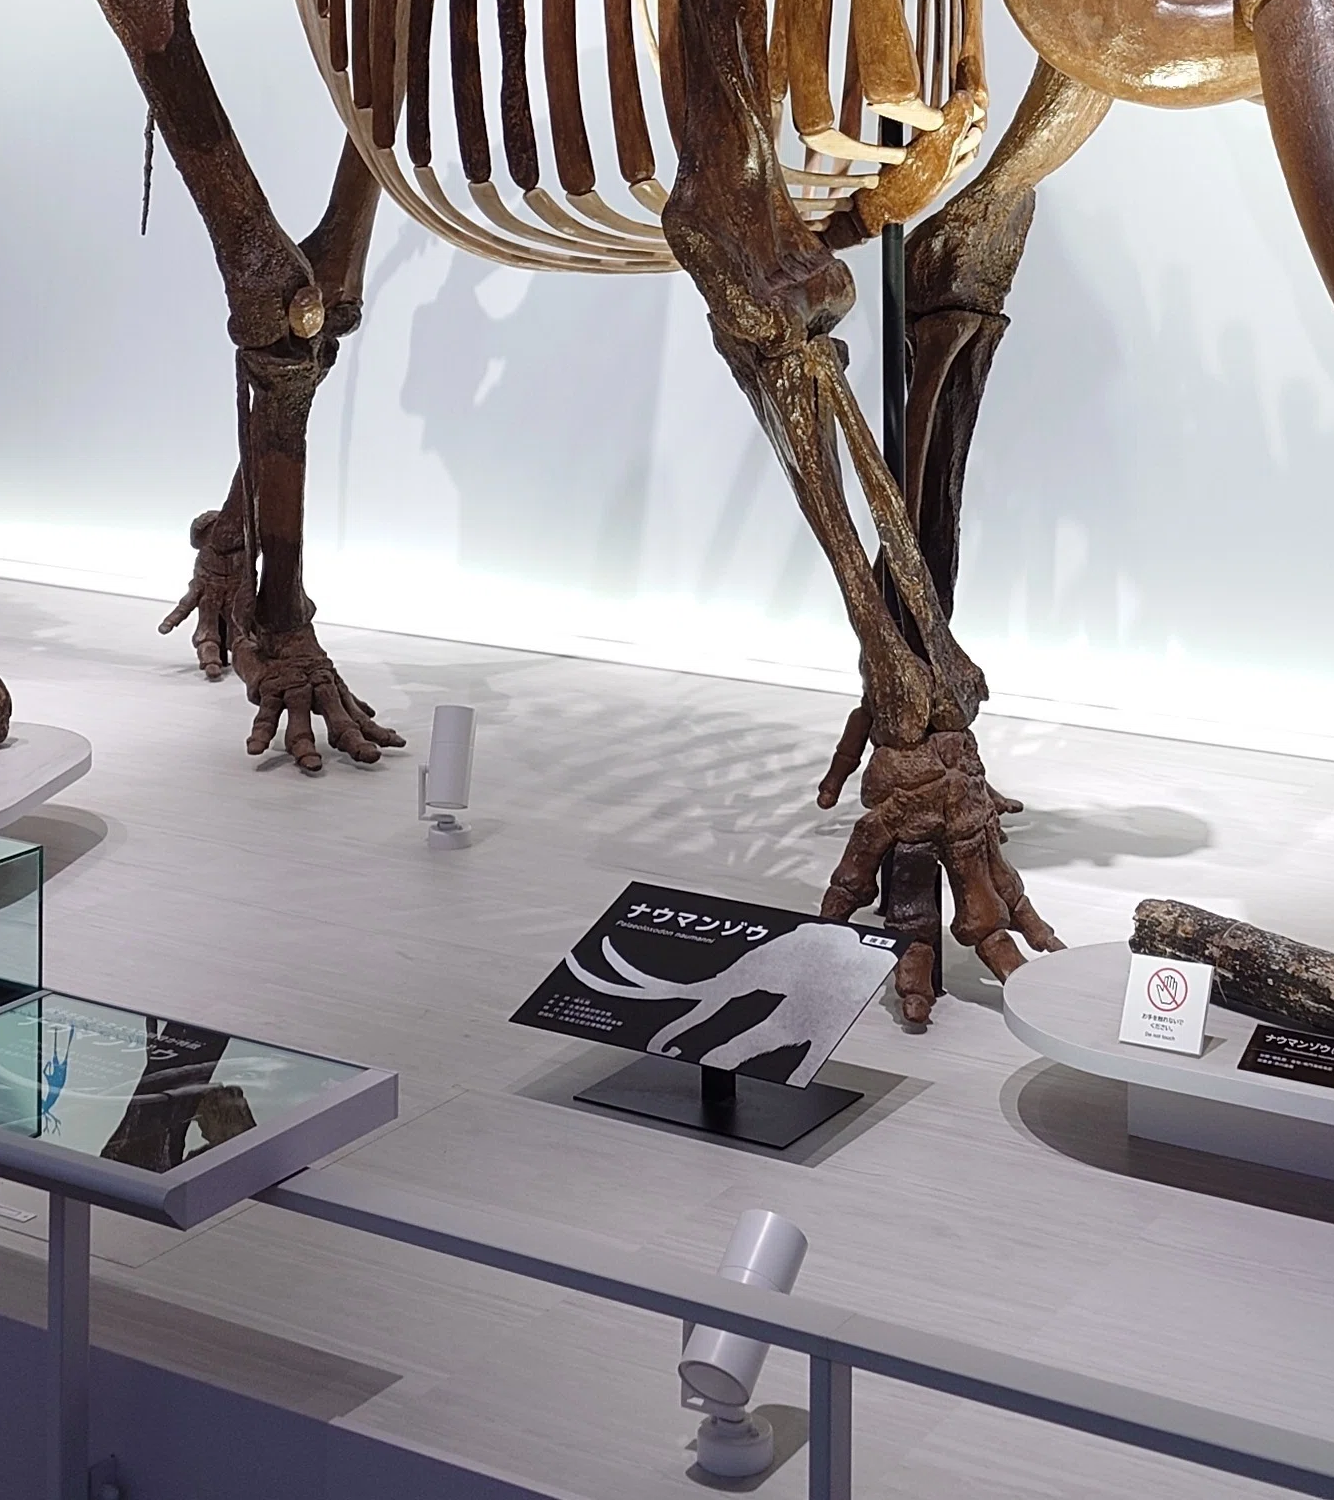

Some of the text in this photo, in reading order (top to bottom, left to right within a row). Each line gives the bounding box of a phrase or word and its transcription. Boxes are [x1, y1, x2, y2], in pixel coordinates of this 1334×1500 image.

[626, 902, 770, 942] ナウマンゾウ
